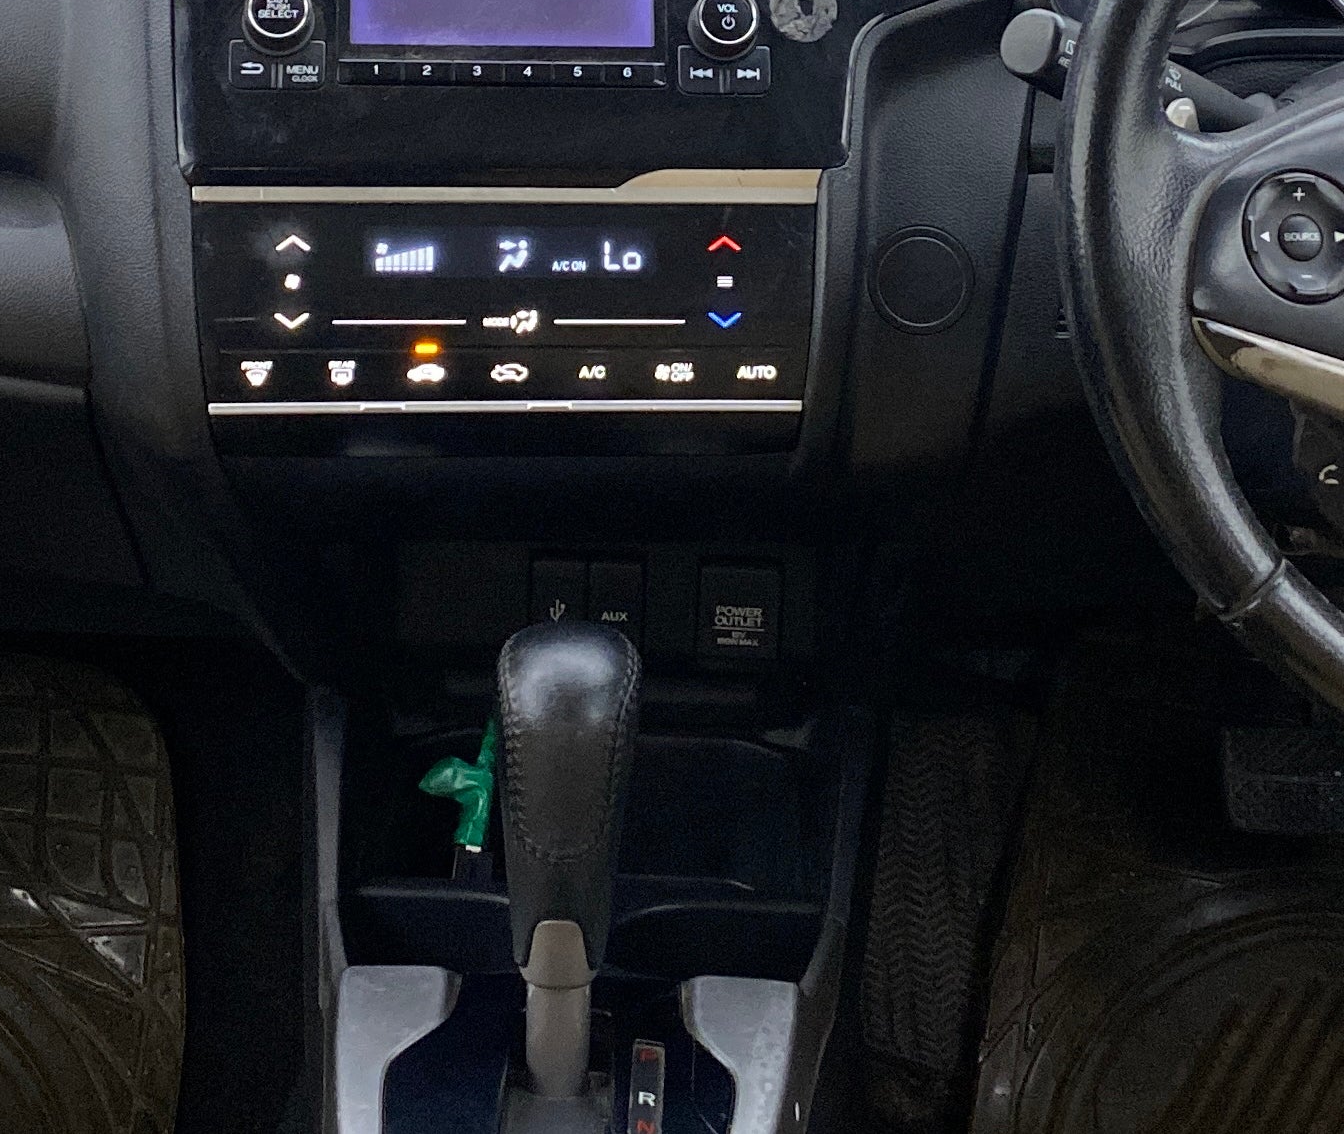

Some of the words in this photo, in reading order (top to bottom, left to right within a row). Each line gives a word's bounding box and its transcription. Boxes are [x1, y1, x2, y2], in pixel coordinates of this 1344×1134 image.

[257, 9, 299, 19] SELECT
[717, 3, 739, 13] VOL
[286, 64, 319, 74] MENU
[373, 64, 380, 75] 1
[422, 65, 432, 76] 2
[472, 65, 482, 76] 3
[522, 66, 532, 77] 4
[573, 66, 582, 77] 5
[622, 67, 632, 78] 6
[291, 74, 318, 82] CLOCK
[1164, 76, 1183, 92] PULL
[603, 240, 642, 271] Lo
[552, 260, 570, 272] A/C
[571, 260, 587, 272] ON
[578, 365, 606, 380] A/C
[736, 365, 777, 380] AUTO
[601, 610, 629, 622] AUX
[715, 605, 762, 618] POWER
[714, 616, 762, 628] OUTLET
[638, 1091, 656, 1106] R
